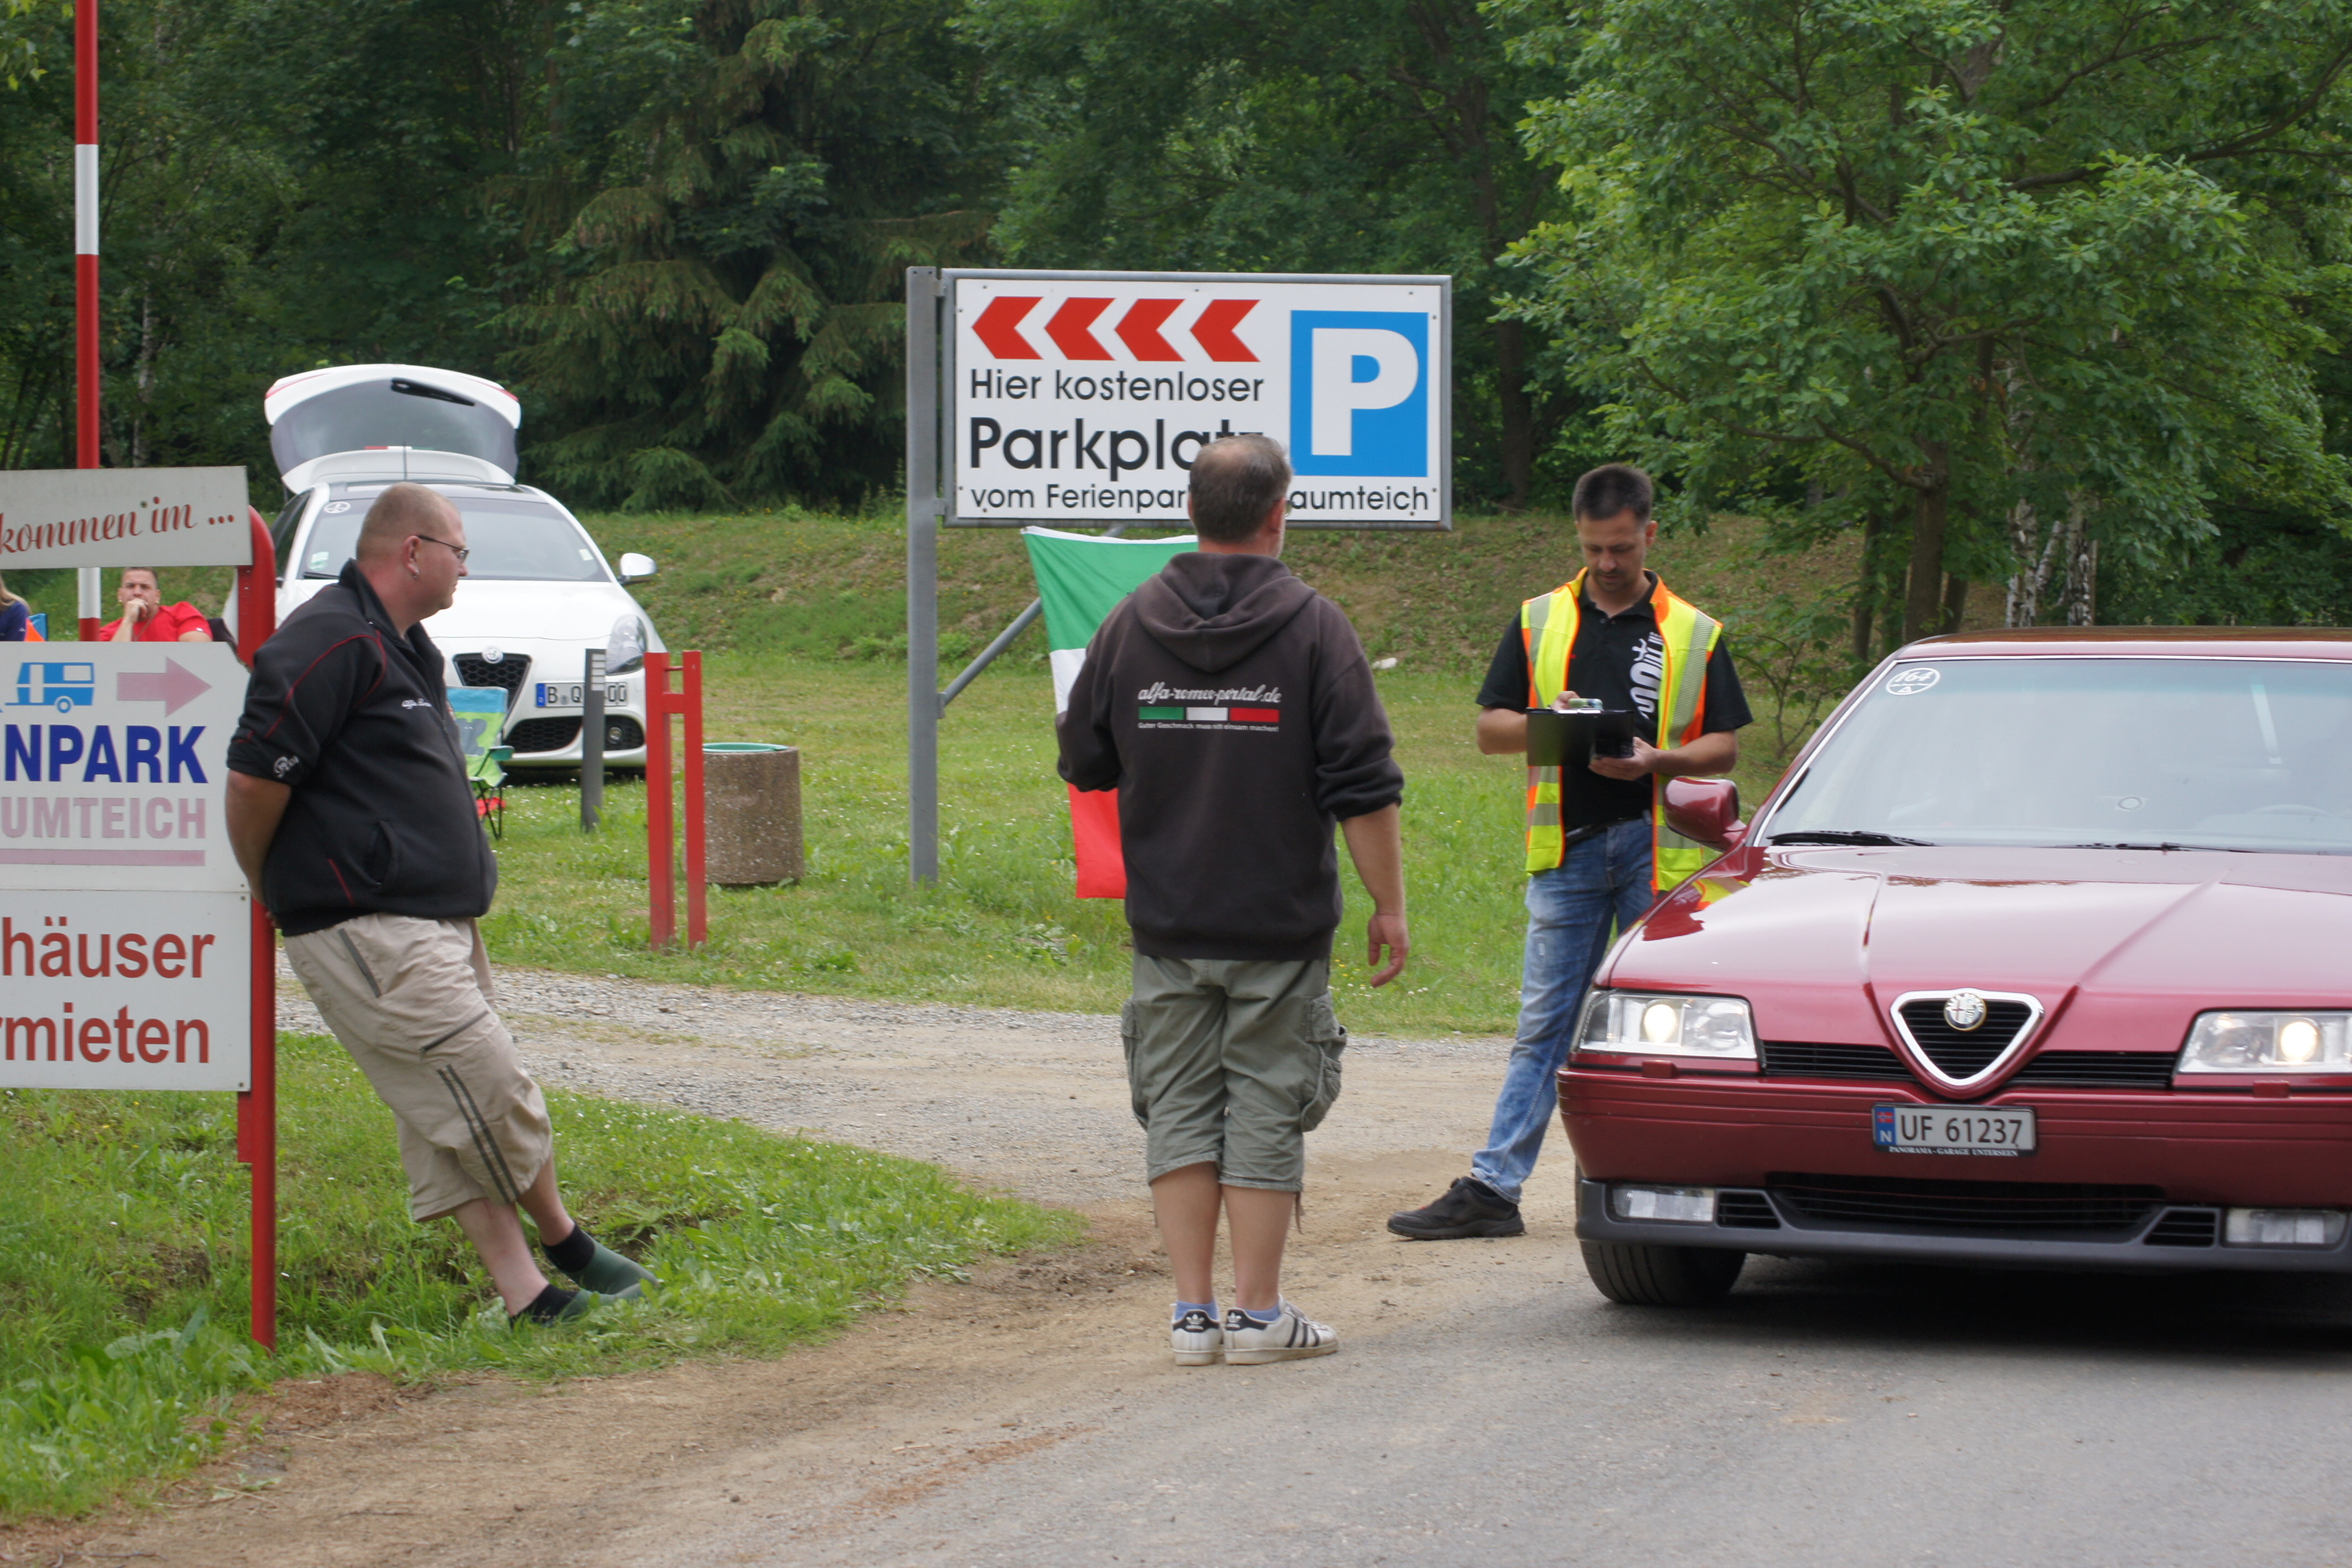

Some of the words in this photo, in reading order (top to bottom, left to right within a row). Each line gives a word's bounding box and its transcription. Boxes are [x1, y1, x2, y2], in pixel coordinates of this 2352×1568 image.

[971, 369, 1042, 400] Hier
[1057, 370, 1264, 402] kostenloser
[1312, 328, 1418, 456] P
[971, 417, 1264, 482] Parkpla
[152, 496, 198, 533] im
[972, 489, 1035, 510] vom
[1048, 484, 1191, 513] Ferienpar
[1290, 486, 1429, 510] aumteich
[547, 686, 558, 703] B
[604, 684, 627, 702] 00
[5, 724, 209, 783] NPARK
[1, 797, 206, 838] UMTEICH
[2, 916, 216, 978] häuser
[0, 1002, 210, 1064] mieten
[1880, 1130, 1892, 1143] N
[1900, 1115, 1933, 1141] UF
[1946, 1117, 2022, 1144] 61237
